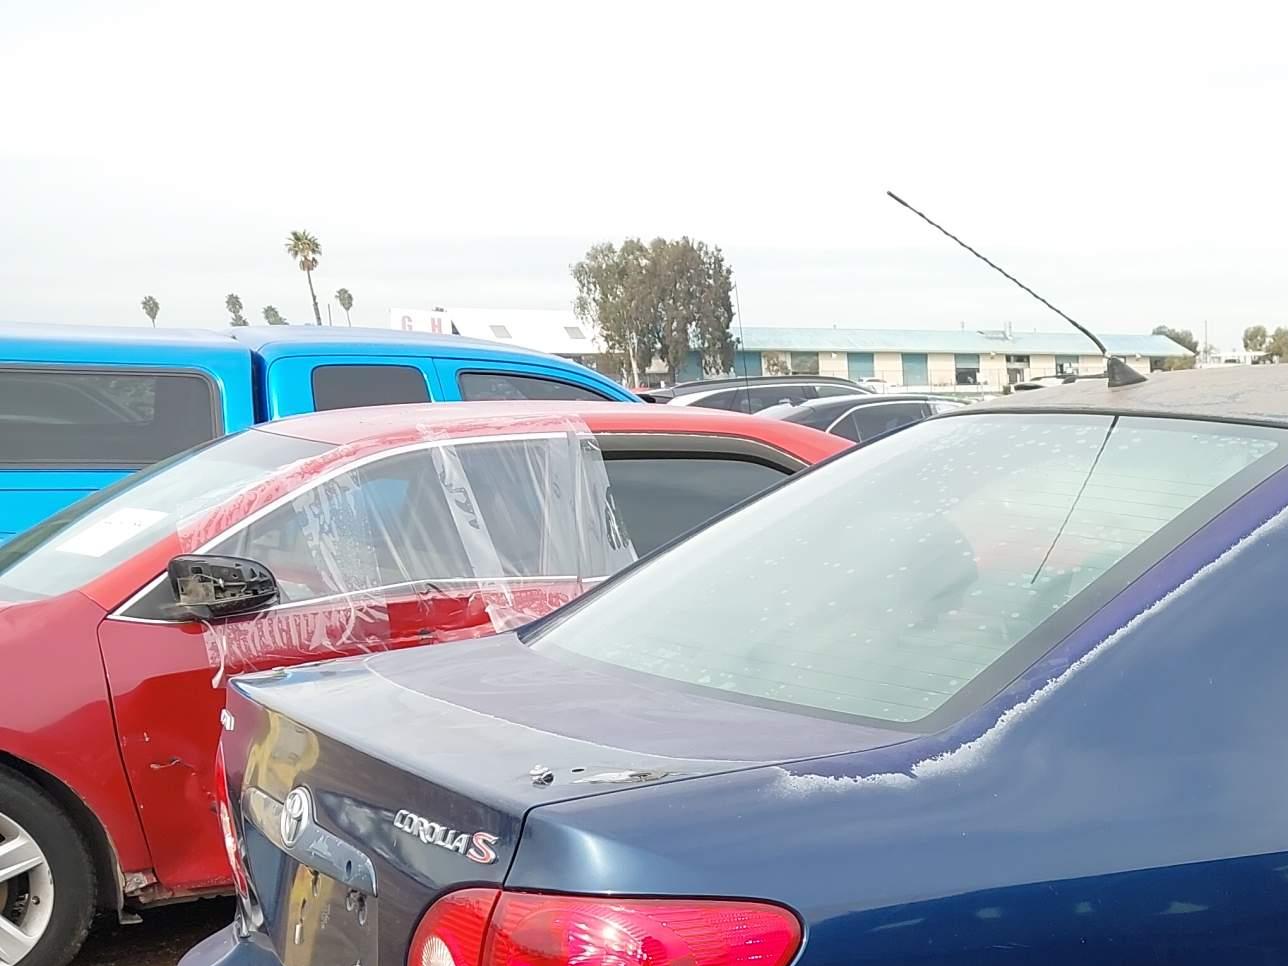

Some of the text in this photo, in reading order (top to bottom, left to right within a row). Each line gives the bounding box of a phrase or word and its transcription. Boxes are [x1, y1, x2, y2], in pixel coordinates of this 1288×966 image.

[431, 317, 442, 334] H
[393, 809, 500, 864] COROLLA S
